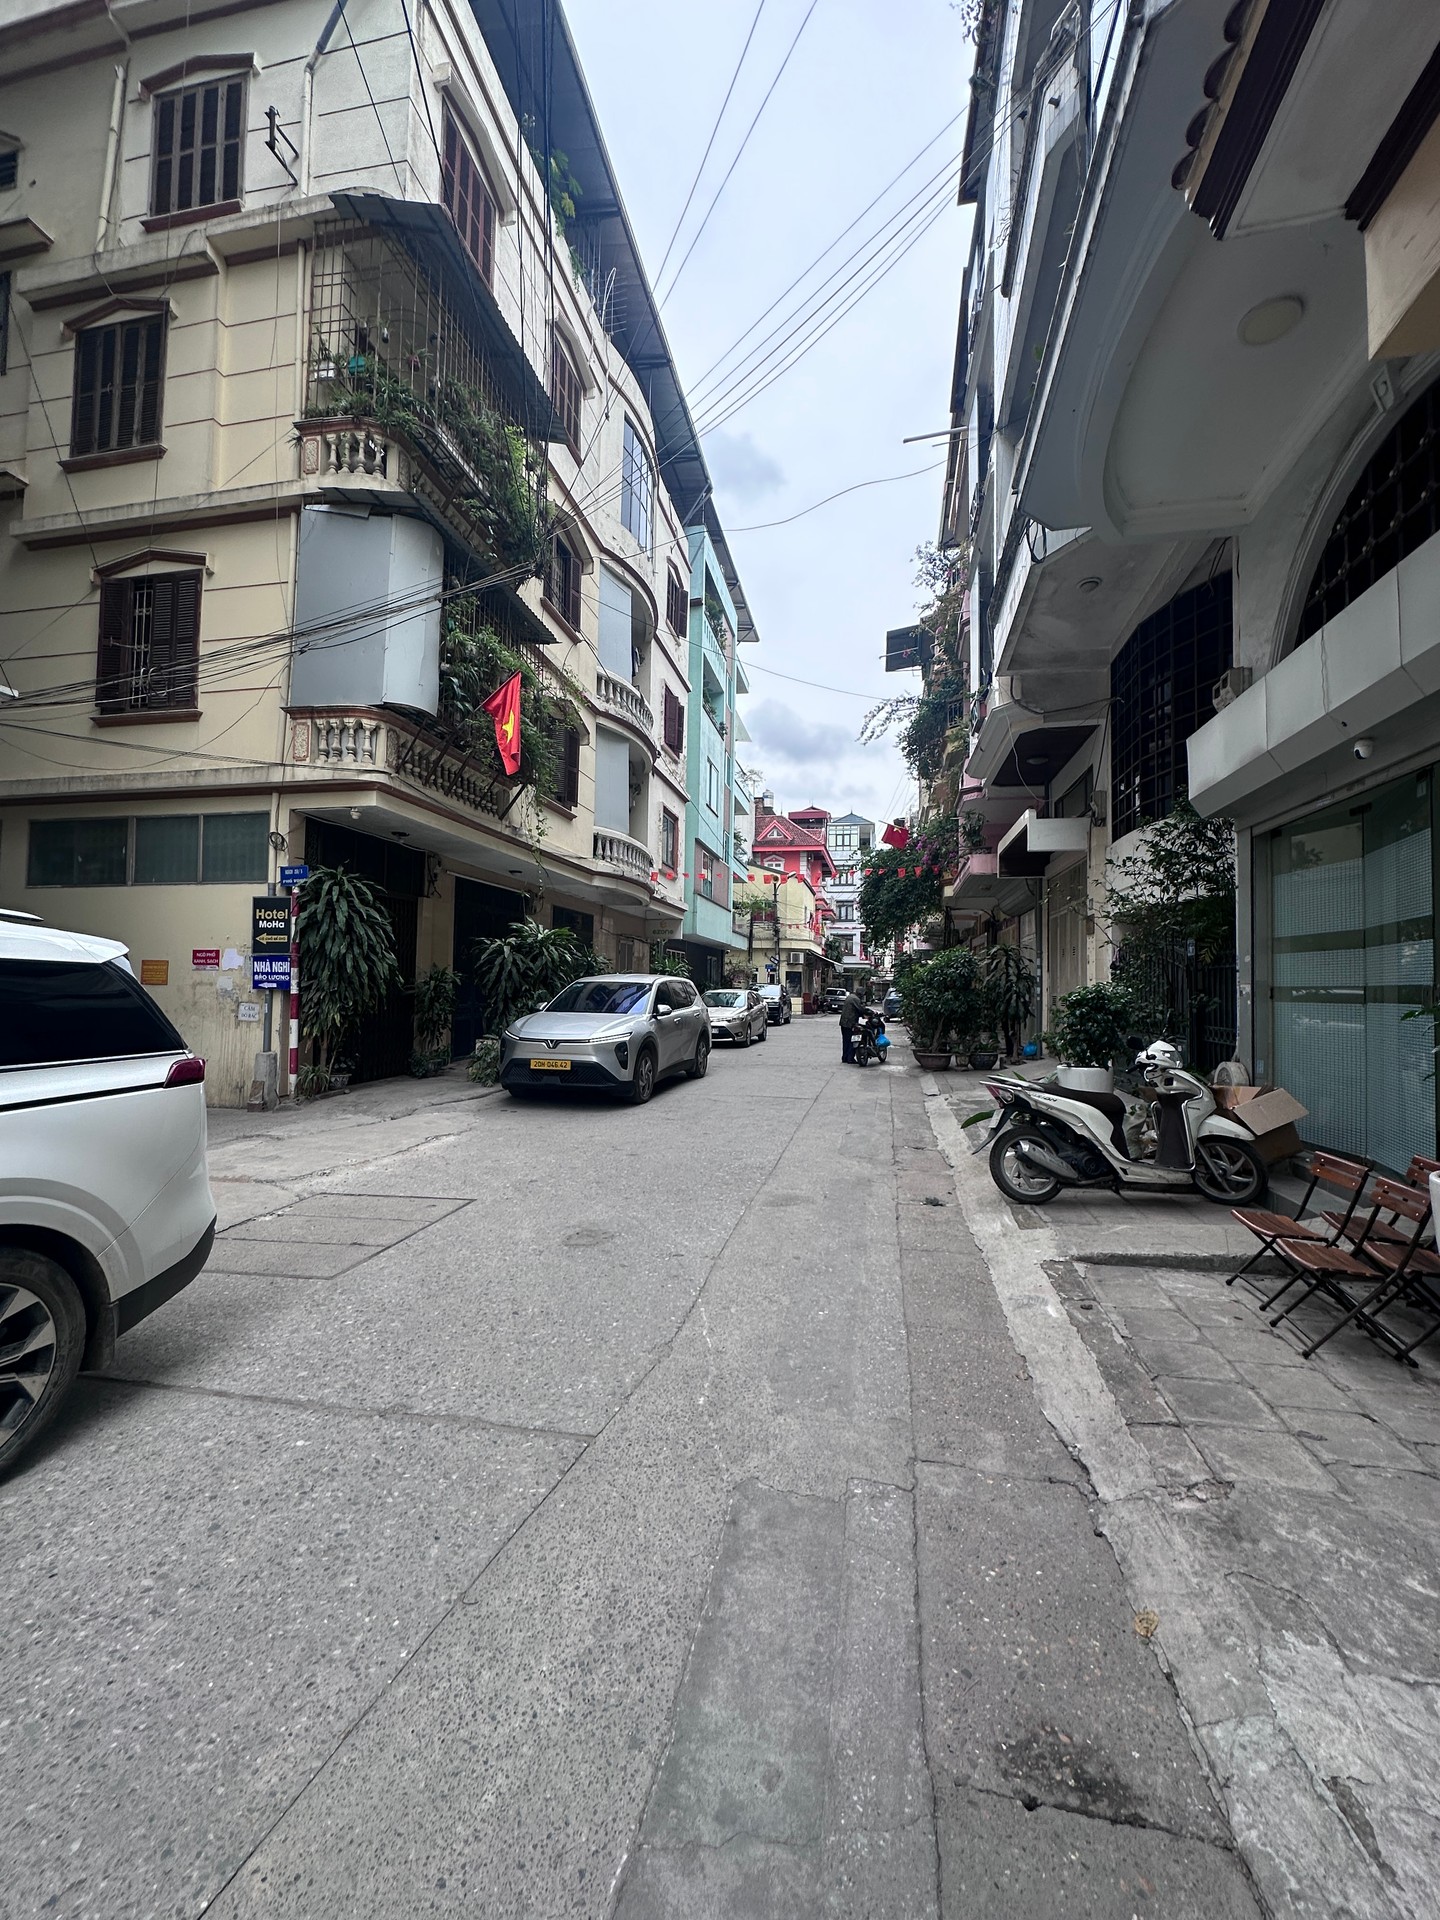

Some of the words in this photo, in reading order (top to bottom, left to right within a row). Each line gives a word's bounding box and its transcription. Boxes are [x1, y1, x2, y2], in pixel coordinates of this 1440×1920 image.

[256, 908, 288, 920] Hotel
[259, 920, 285, 929] MoHa
[254, 959, 271, 973] NHÀ
[272, 958, 290, 973] NGHỈ
